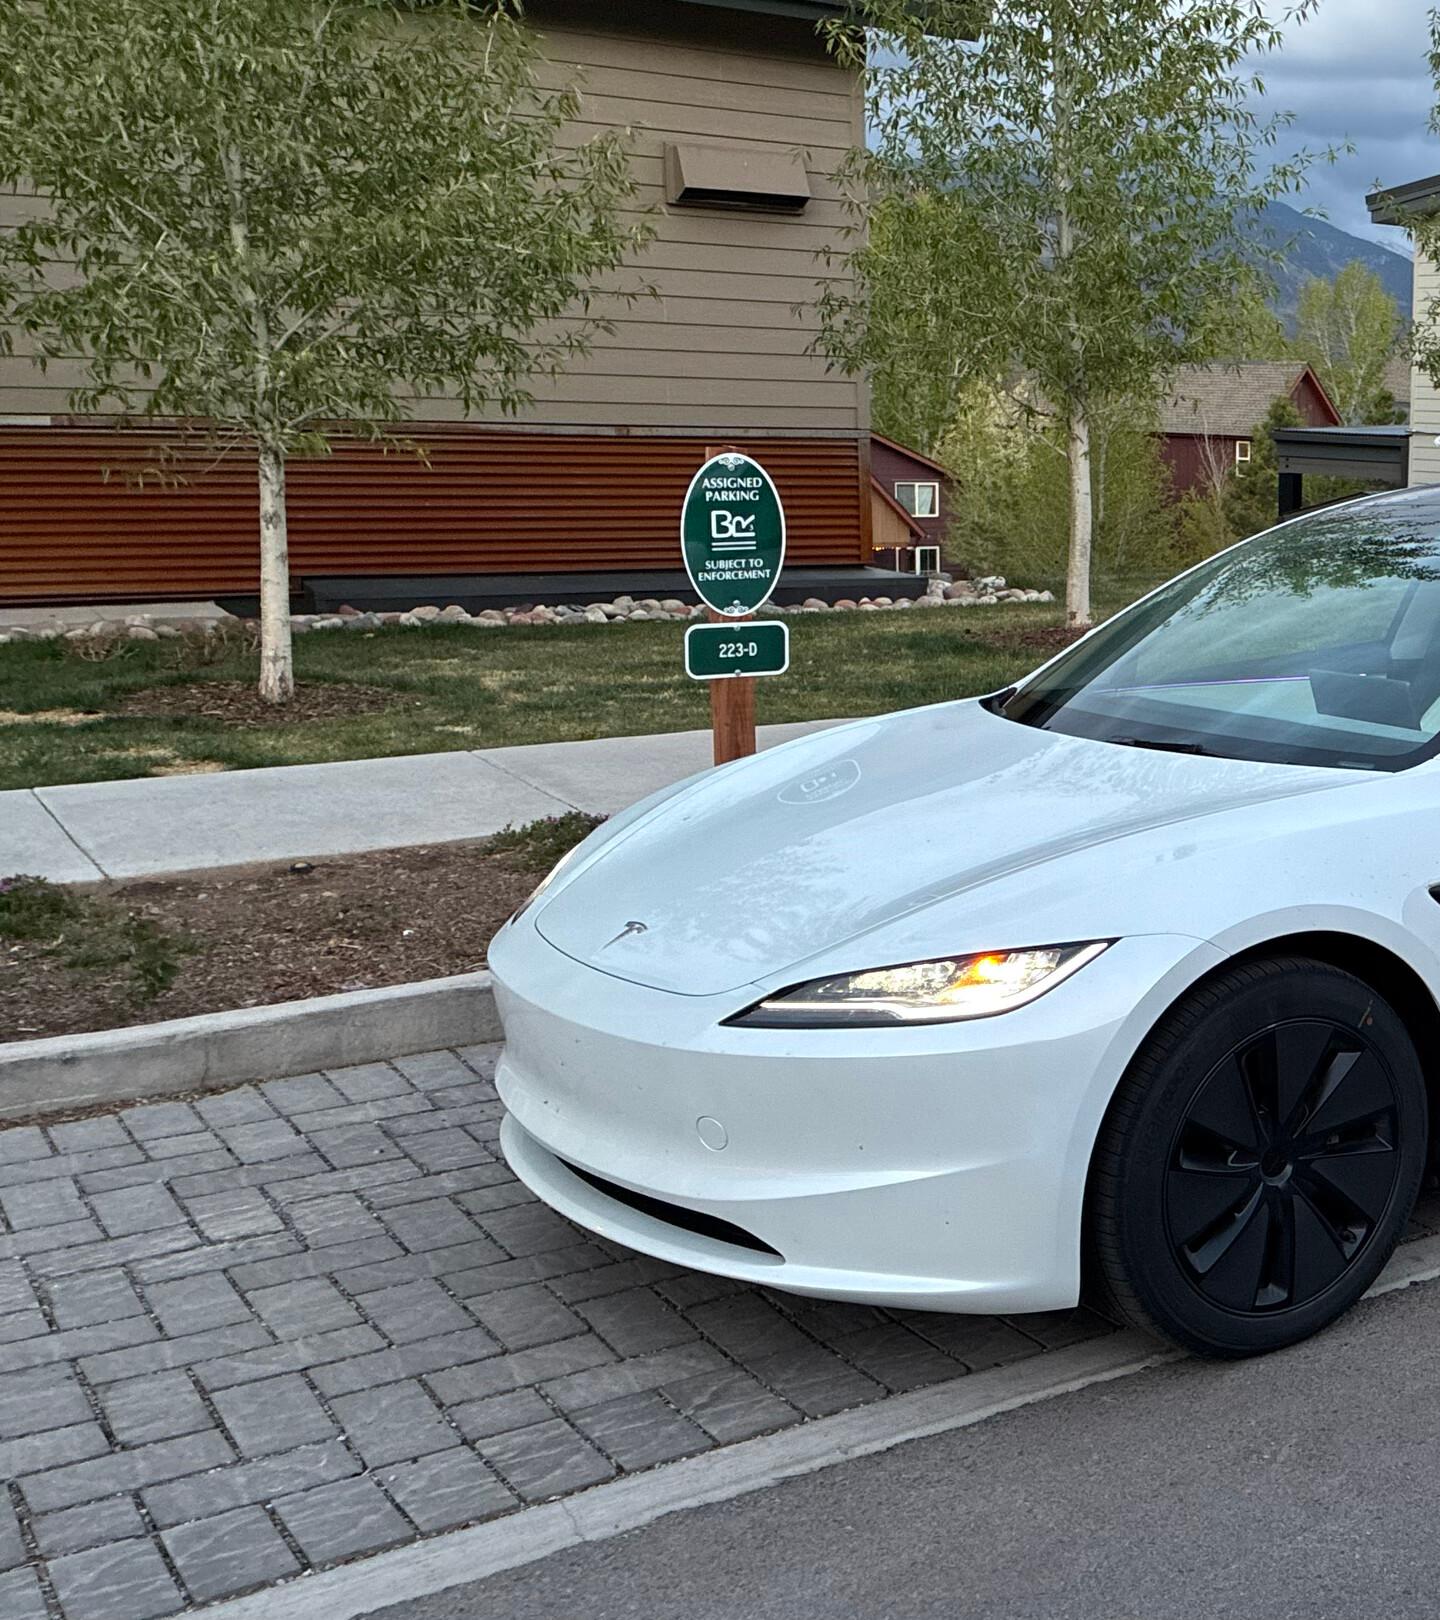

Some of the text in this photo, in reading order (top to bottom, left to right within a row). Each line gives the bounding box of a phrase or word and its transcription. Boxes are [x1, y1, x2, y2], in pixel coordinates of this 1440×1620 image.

[702, 477, 763, 489] ASSIGNED
[705, 490, 760, 502] PARKING
[704, 558, 763, 571] SUBJECT TO
[698, 569, 771, 582] ENFORCEMENT
[718, 642, 758, 658] 223-D
